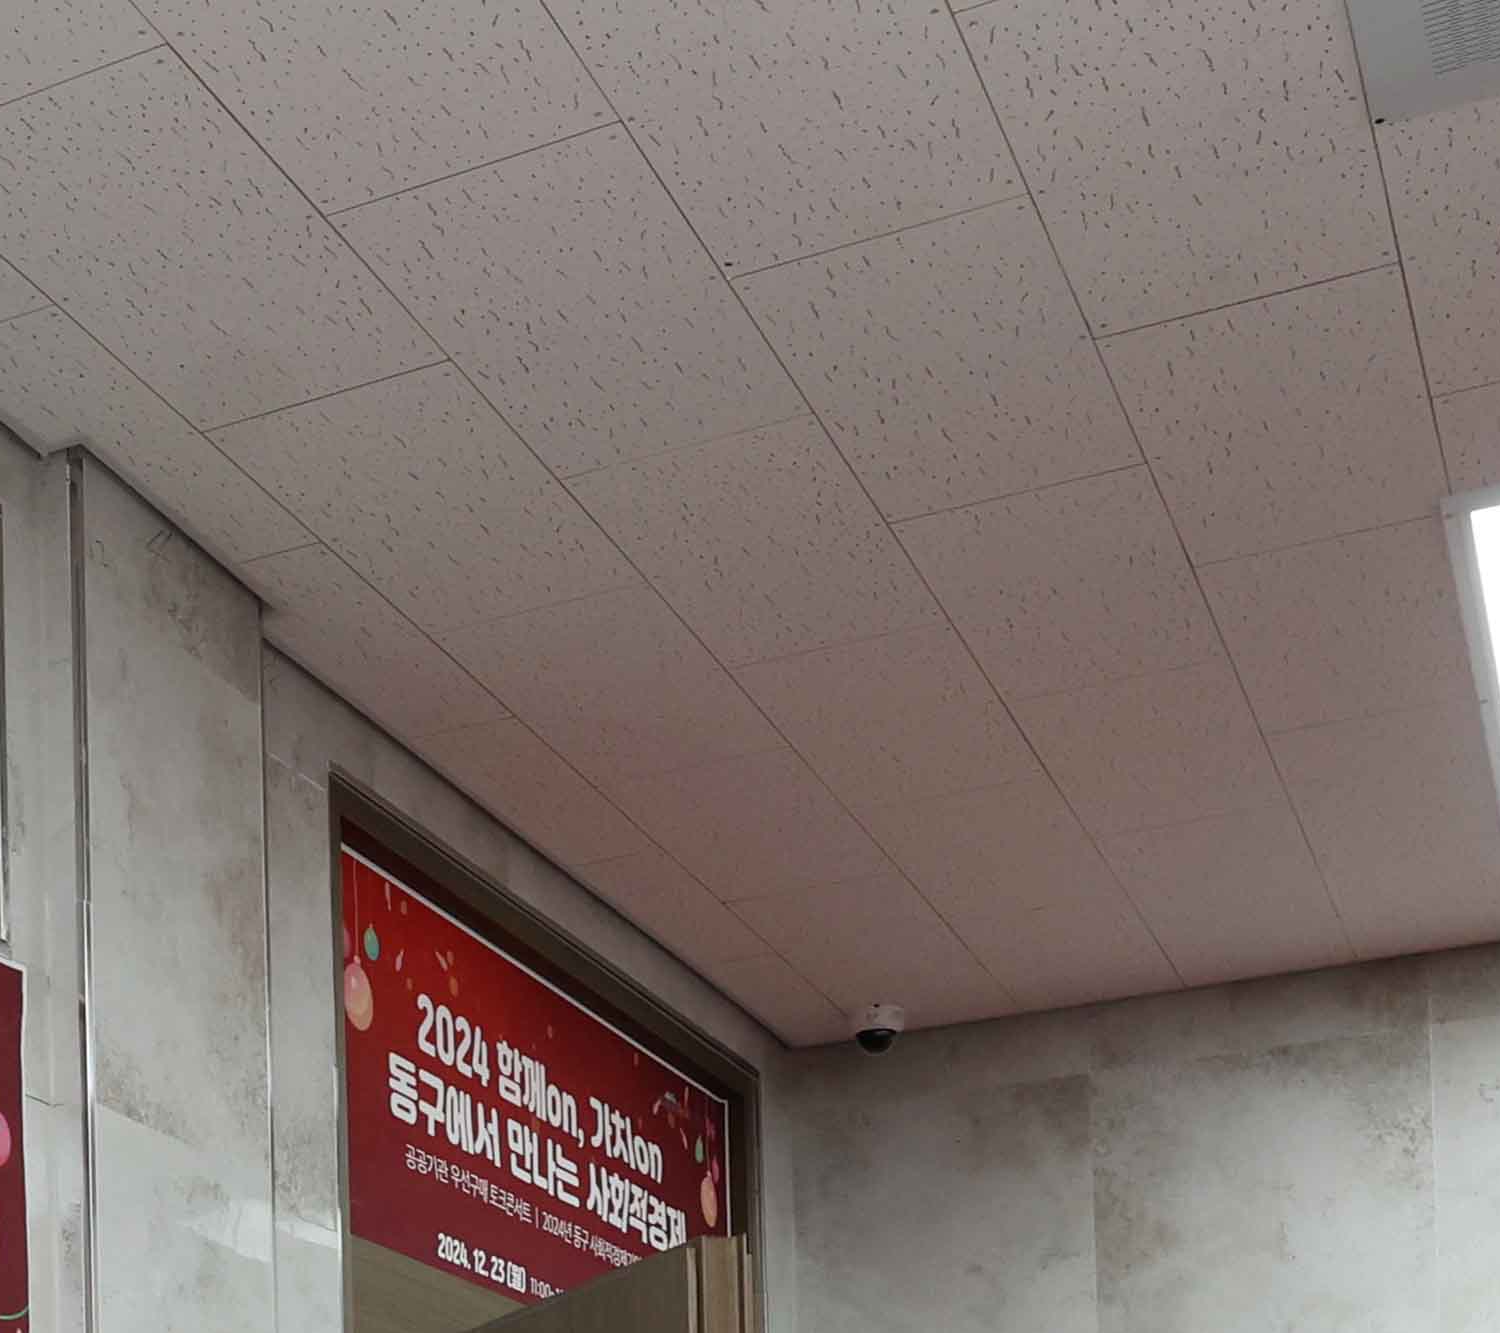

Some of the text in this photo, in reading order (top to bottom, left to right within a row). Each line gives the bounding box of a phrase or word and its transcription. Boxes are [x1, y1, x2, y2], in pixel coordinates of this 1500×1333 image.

[388, 1052, 687, 1252] 동구에서 만나는 사회적경제
[416, 993, 665, 1184] 2024 함께on, 가치on
[404, 1143, 450, 1185] 공공기관
[450, 1166, 489, 1203] 우선구매
[489, 1187, 533, 1224] 토크콘서트
[573, 1225, 590, 1250] 동구
[437, 1232, 472, 1270] 2024.
